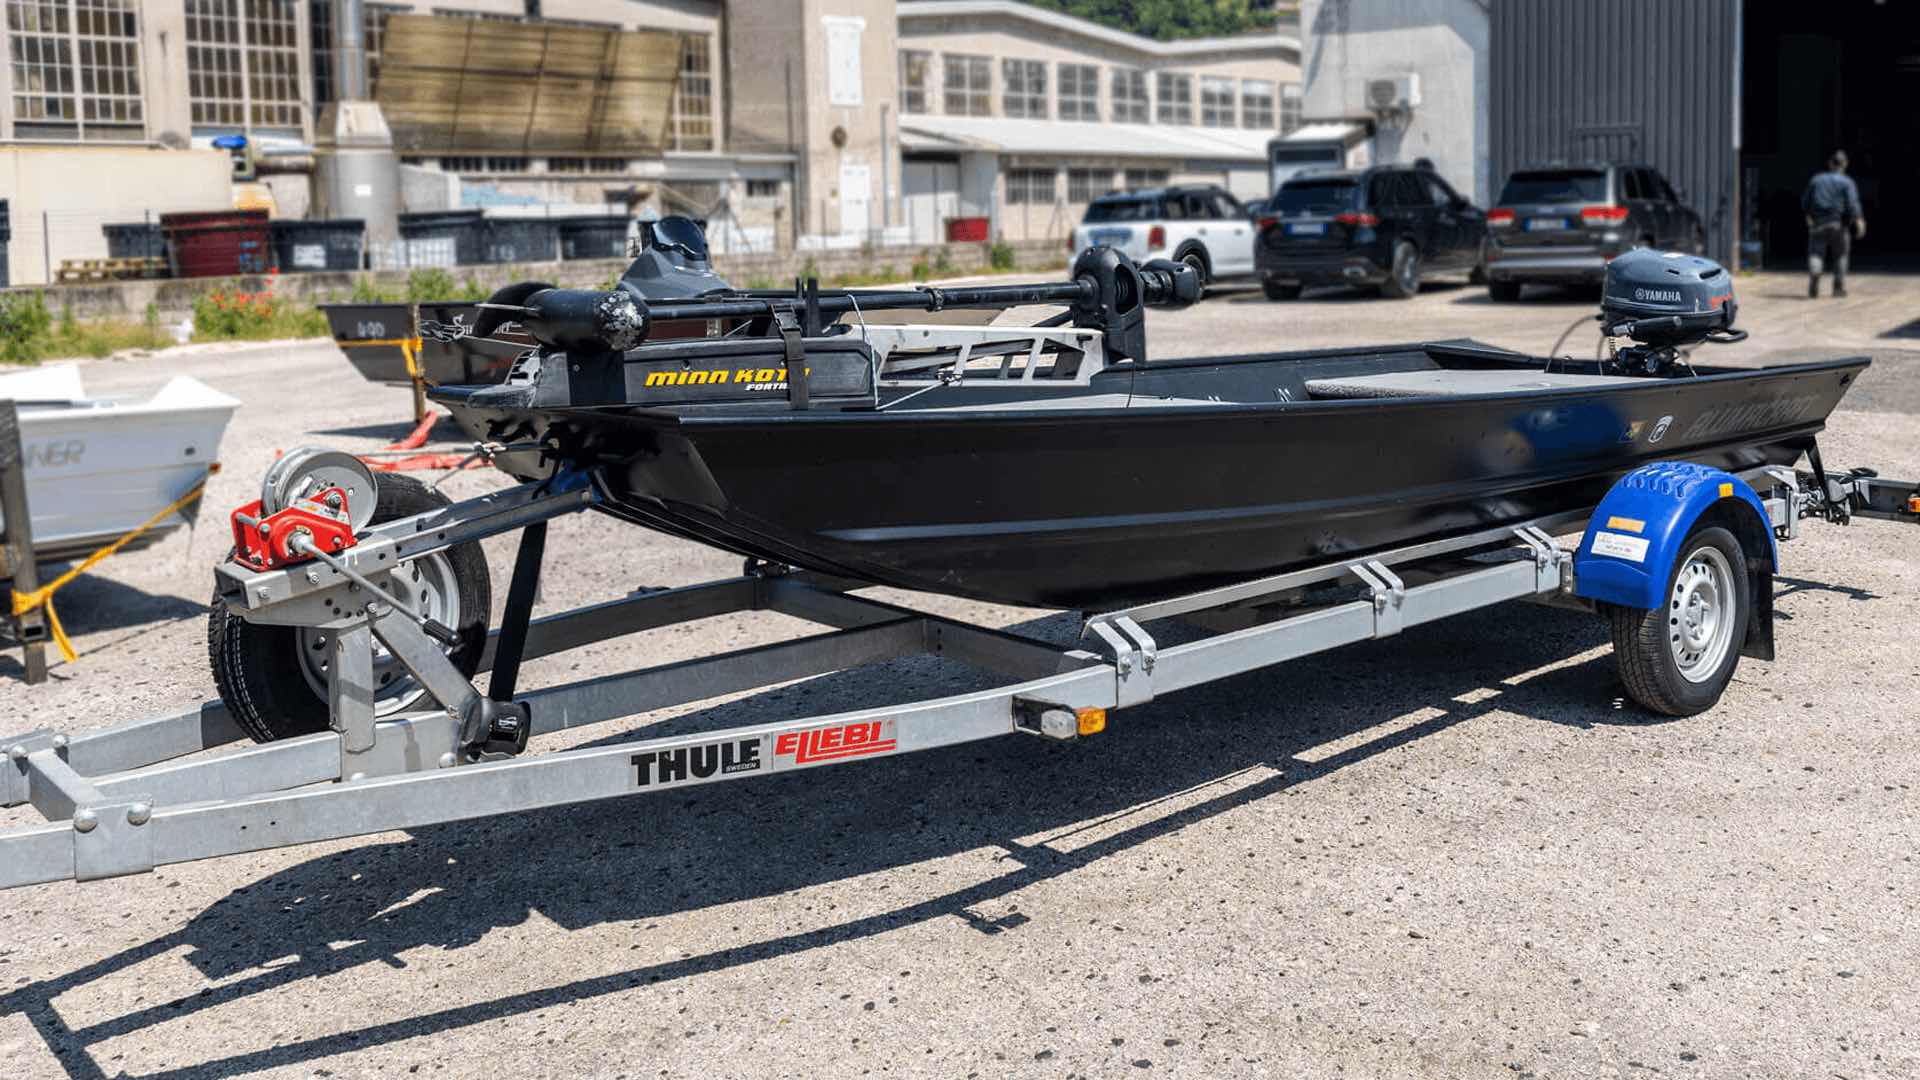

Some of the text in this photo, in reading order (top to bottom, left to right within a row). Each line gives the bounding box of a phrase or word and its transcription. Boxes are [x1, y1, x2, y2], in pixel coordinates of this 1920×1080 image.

[1645, 290, 1681, 302] YAMAHA
[734, 367, 811, 383] KOT
[745, 383, 788, 391] FORTR
[25, 440, 86, 468] NER
[775, 721, 884, 764] ELLEBI
[631, 738, 761, 787] THULE
[725, 762, 758, 773] SWEDEN
